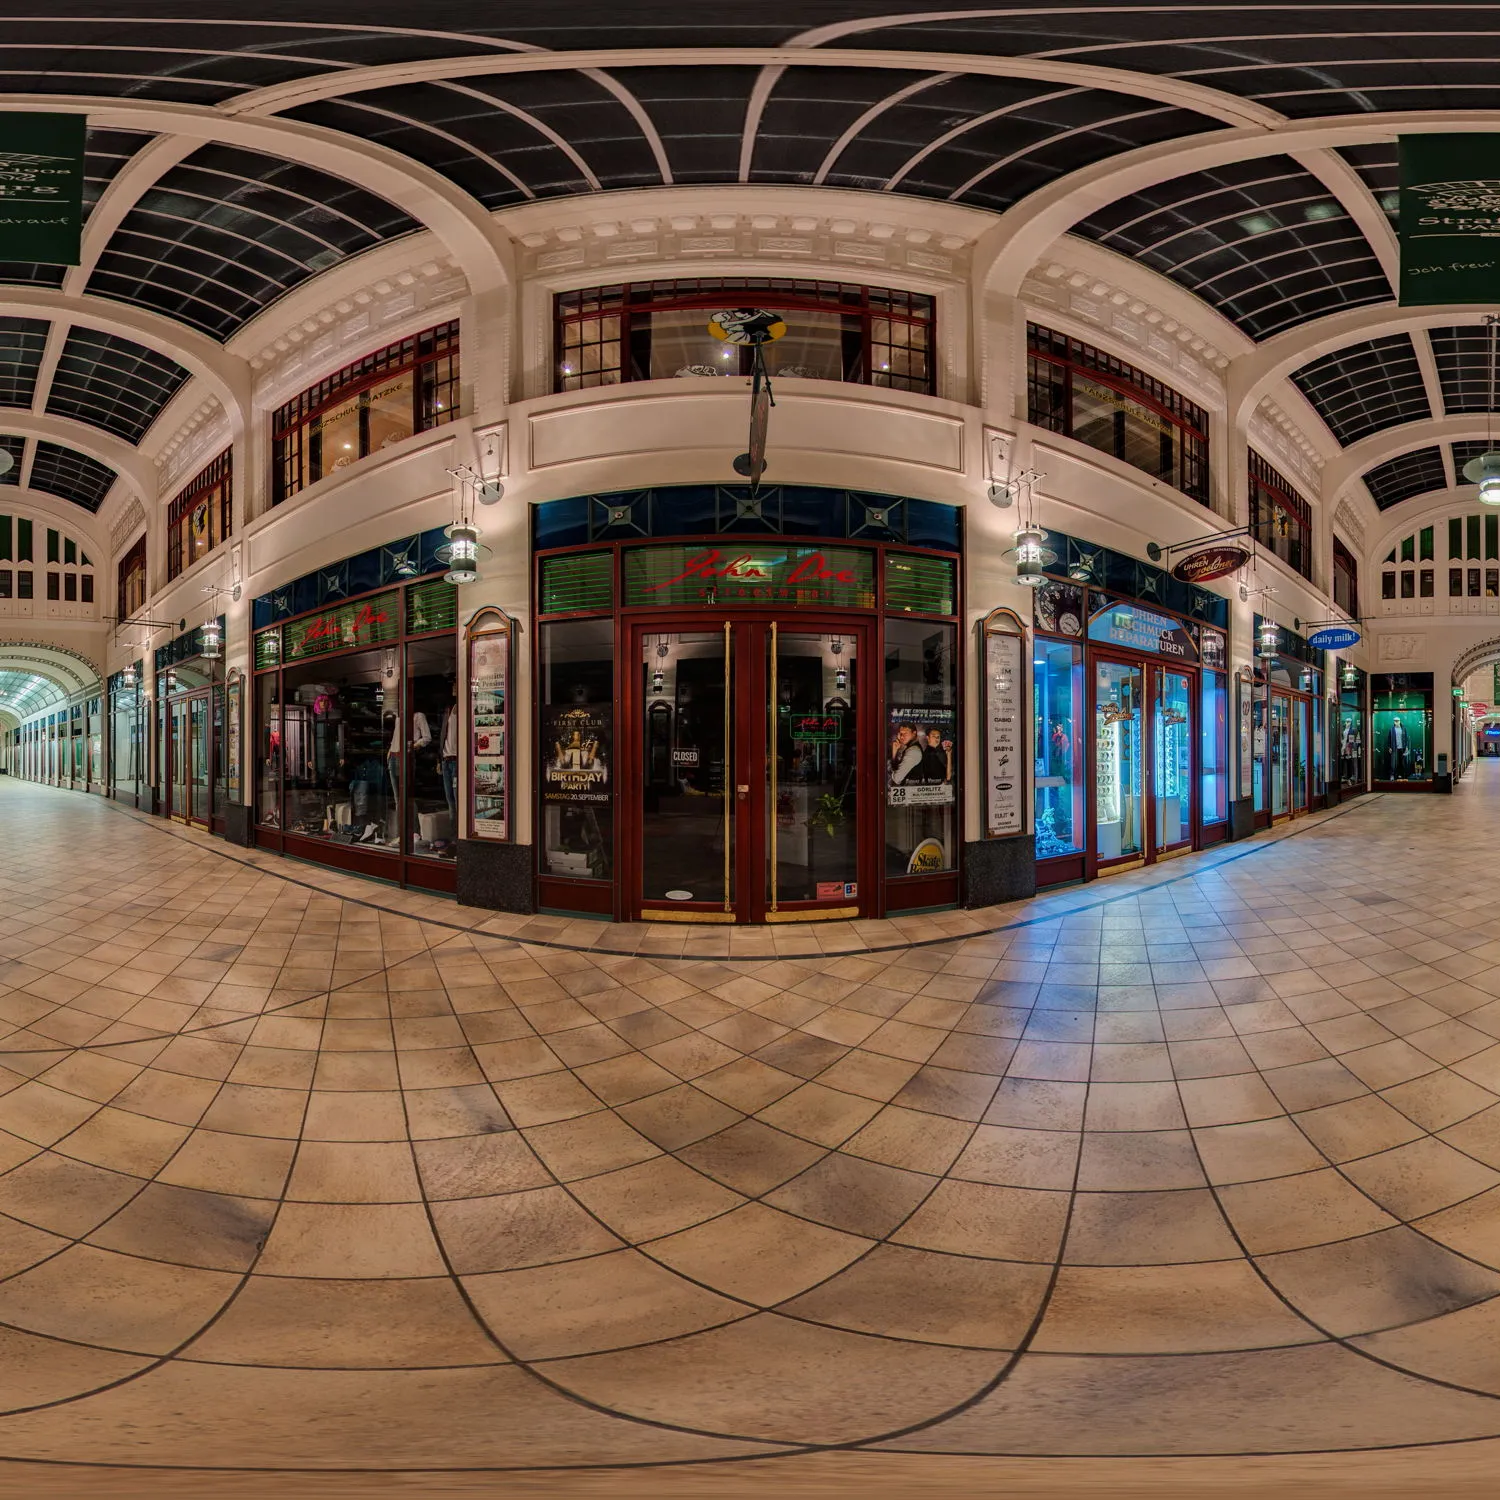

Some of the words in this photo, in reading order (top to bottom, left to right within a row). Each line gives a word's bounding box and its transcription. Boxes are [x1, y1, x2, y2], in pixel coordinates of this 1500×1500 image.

[641, 549, 766, 592] John
[786, 551, 859, 585] Doe
[1183, 559, 1209, 571] UHREN
[1131, 607, 1167, 627] UHREN
[1122, 619, 1174, 642] SCHMUCK
[1109, 627, 1185, 656] REPARATUREN
[1312, 634, 1333, 646] daily
[1334, 633, 1356, 643] milk!
[673, 751, 698, 761] CLOSED
[551, 772, 602, 782] BIRTHDAY
[562, 782, 589, 790] PARTY
[892, 788, 906, 797] 28
